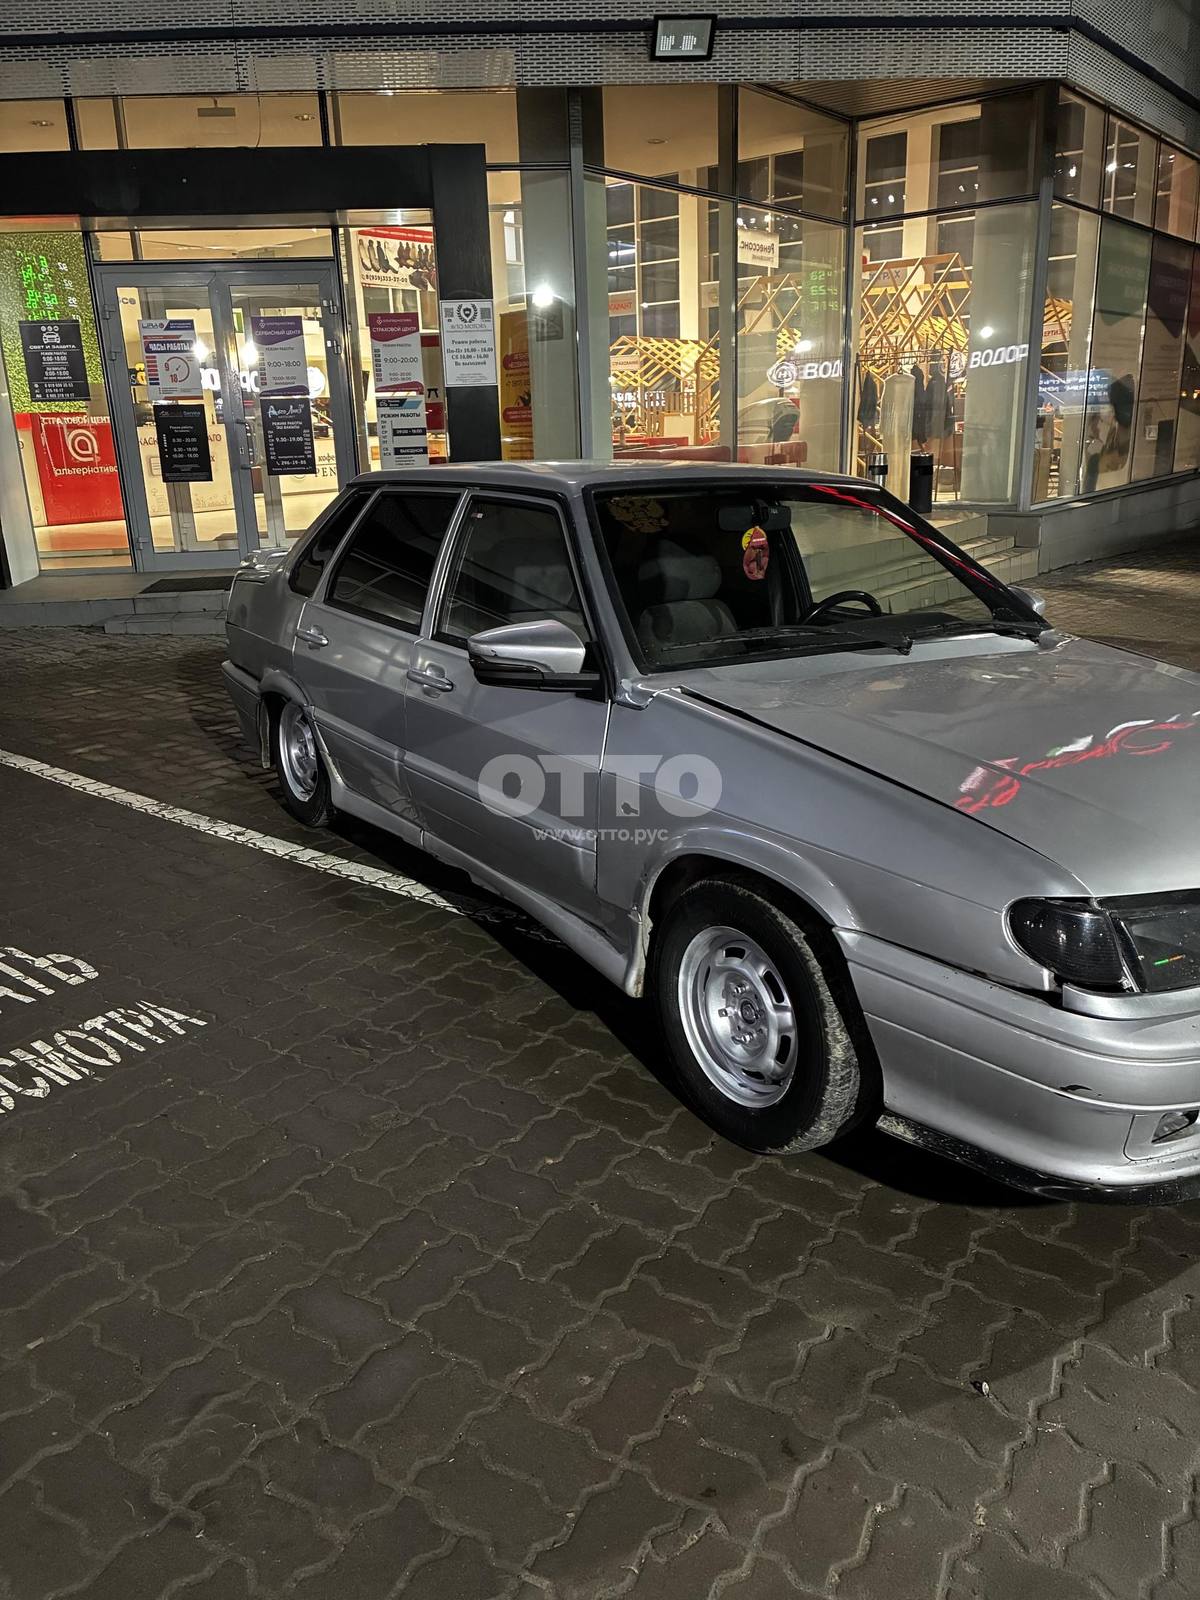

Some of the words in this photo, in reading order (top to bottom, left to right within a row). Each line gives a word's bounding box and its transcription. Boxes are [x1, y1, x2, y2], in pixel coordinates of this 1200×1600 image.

[149, 343, 166, 351] ЧАСЫ
[164, 362, 170, 372] 9
[170, 374, 179, 384] 18
[0, 1000, 208, 1113] СМОТРА
